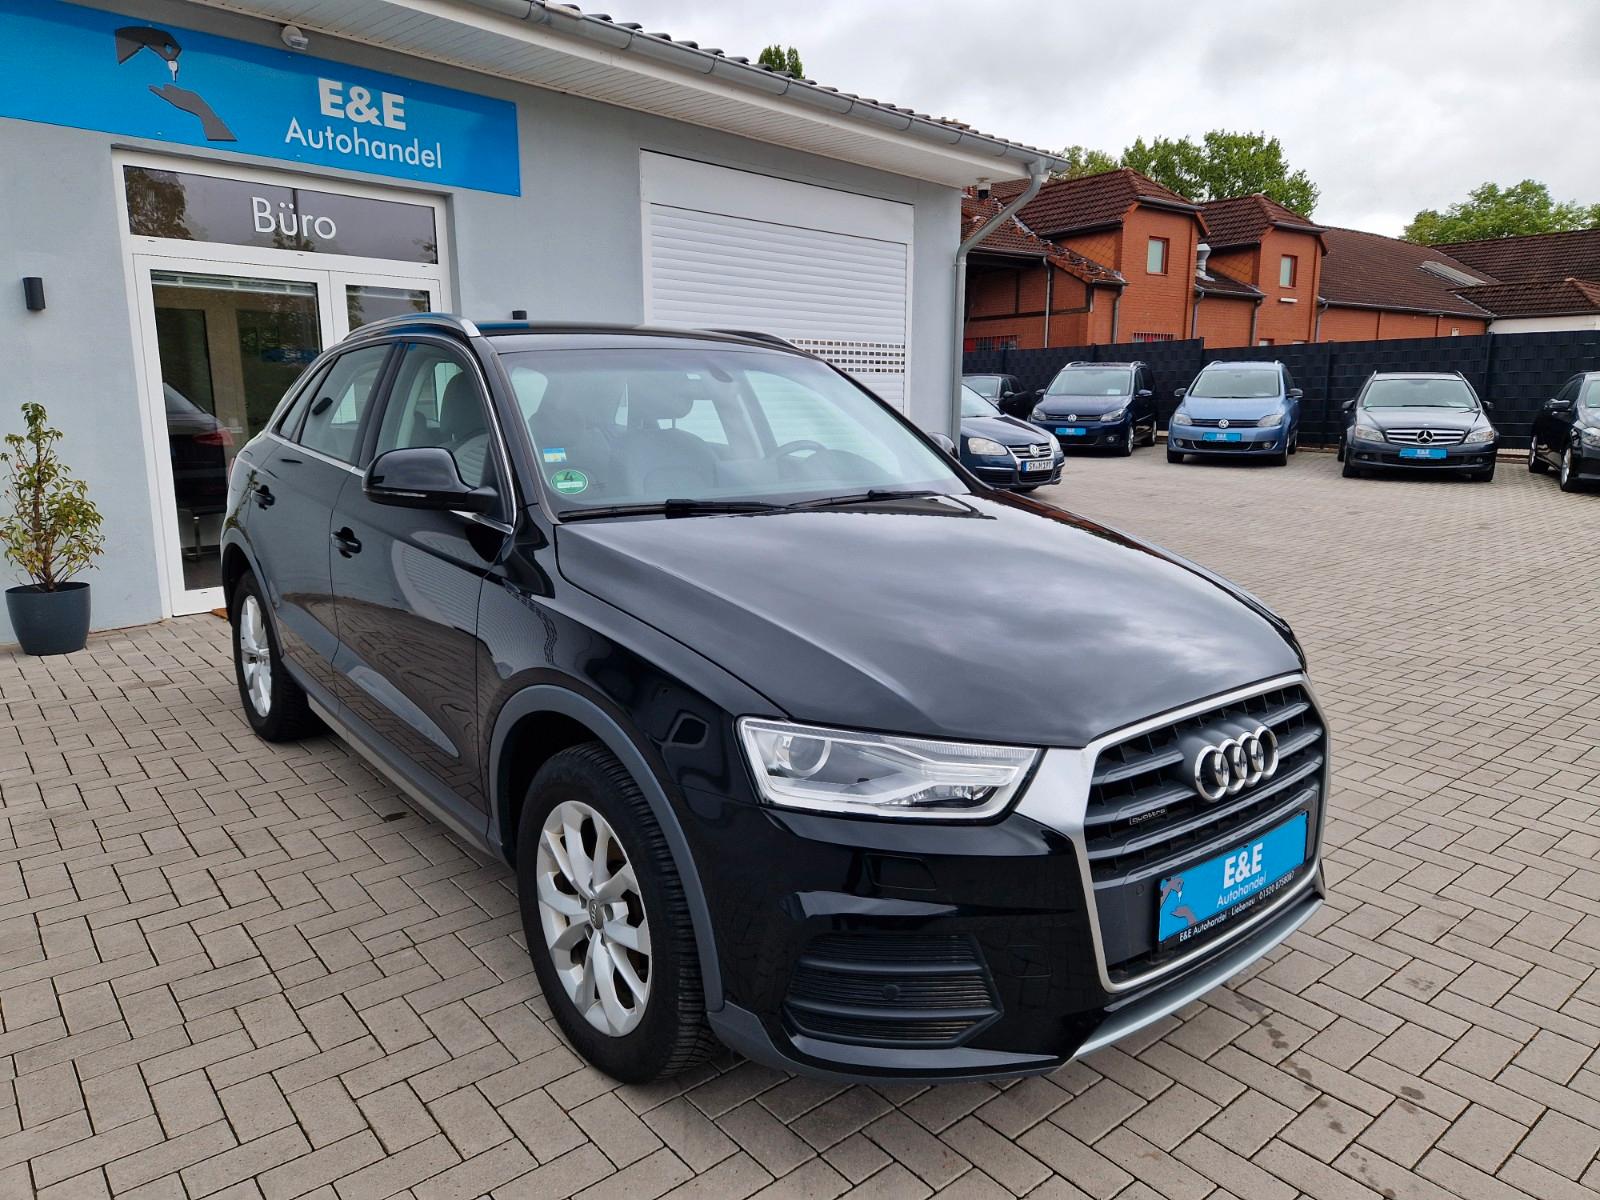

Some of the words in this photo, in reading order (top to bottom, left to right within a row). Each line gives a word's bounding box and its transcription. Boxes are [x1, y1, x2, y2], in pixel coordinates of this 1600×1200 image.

[318, 77, 406, 131] E&E
[285, 116, 442, 169] Autohandel
[252, 196, 337, 240] Büro
[563, 471, 574, 482] 4
[1223, 842, 1263, 889] E&E
[1216, 870, 1267, 908] Autohandel
[1179, 928, 1192, 942] E&E
[1193, 911, 1228, 936] Autohandel
